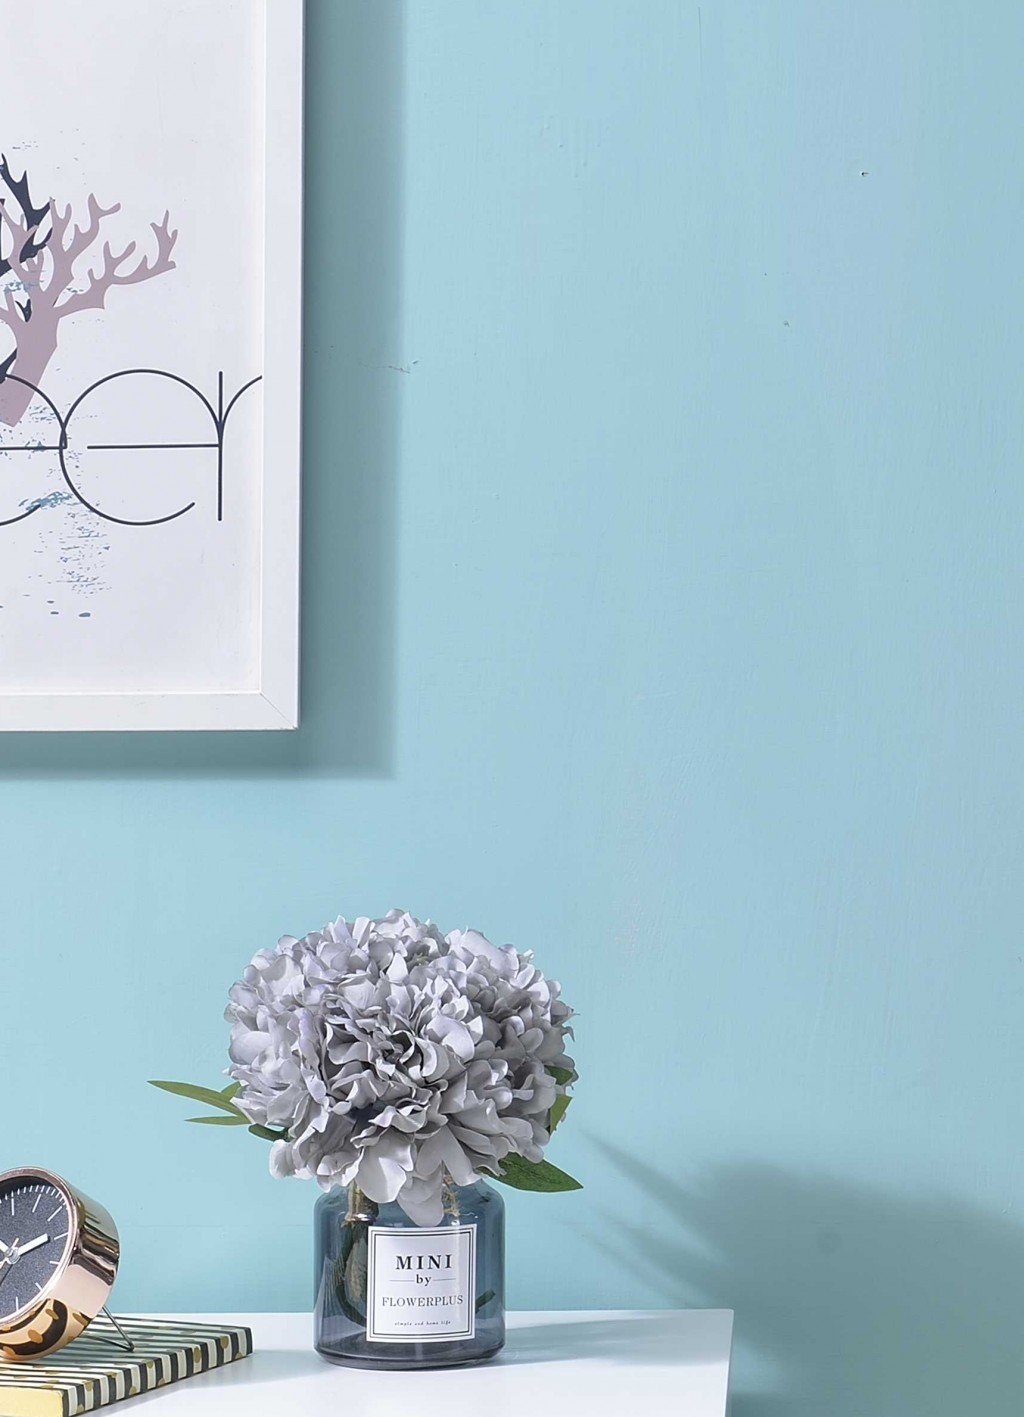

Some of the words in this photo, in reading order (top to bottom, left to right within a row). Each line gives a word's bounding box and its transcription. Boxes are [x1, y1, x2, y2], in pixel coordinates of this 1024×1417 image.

[395, 1254, 453, 1270] MINI
[416, 1274, 432, 1287] by
[382, 1295, 464, 1308] FLOWERPLUS
